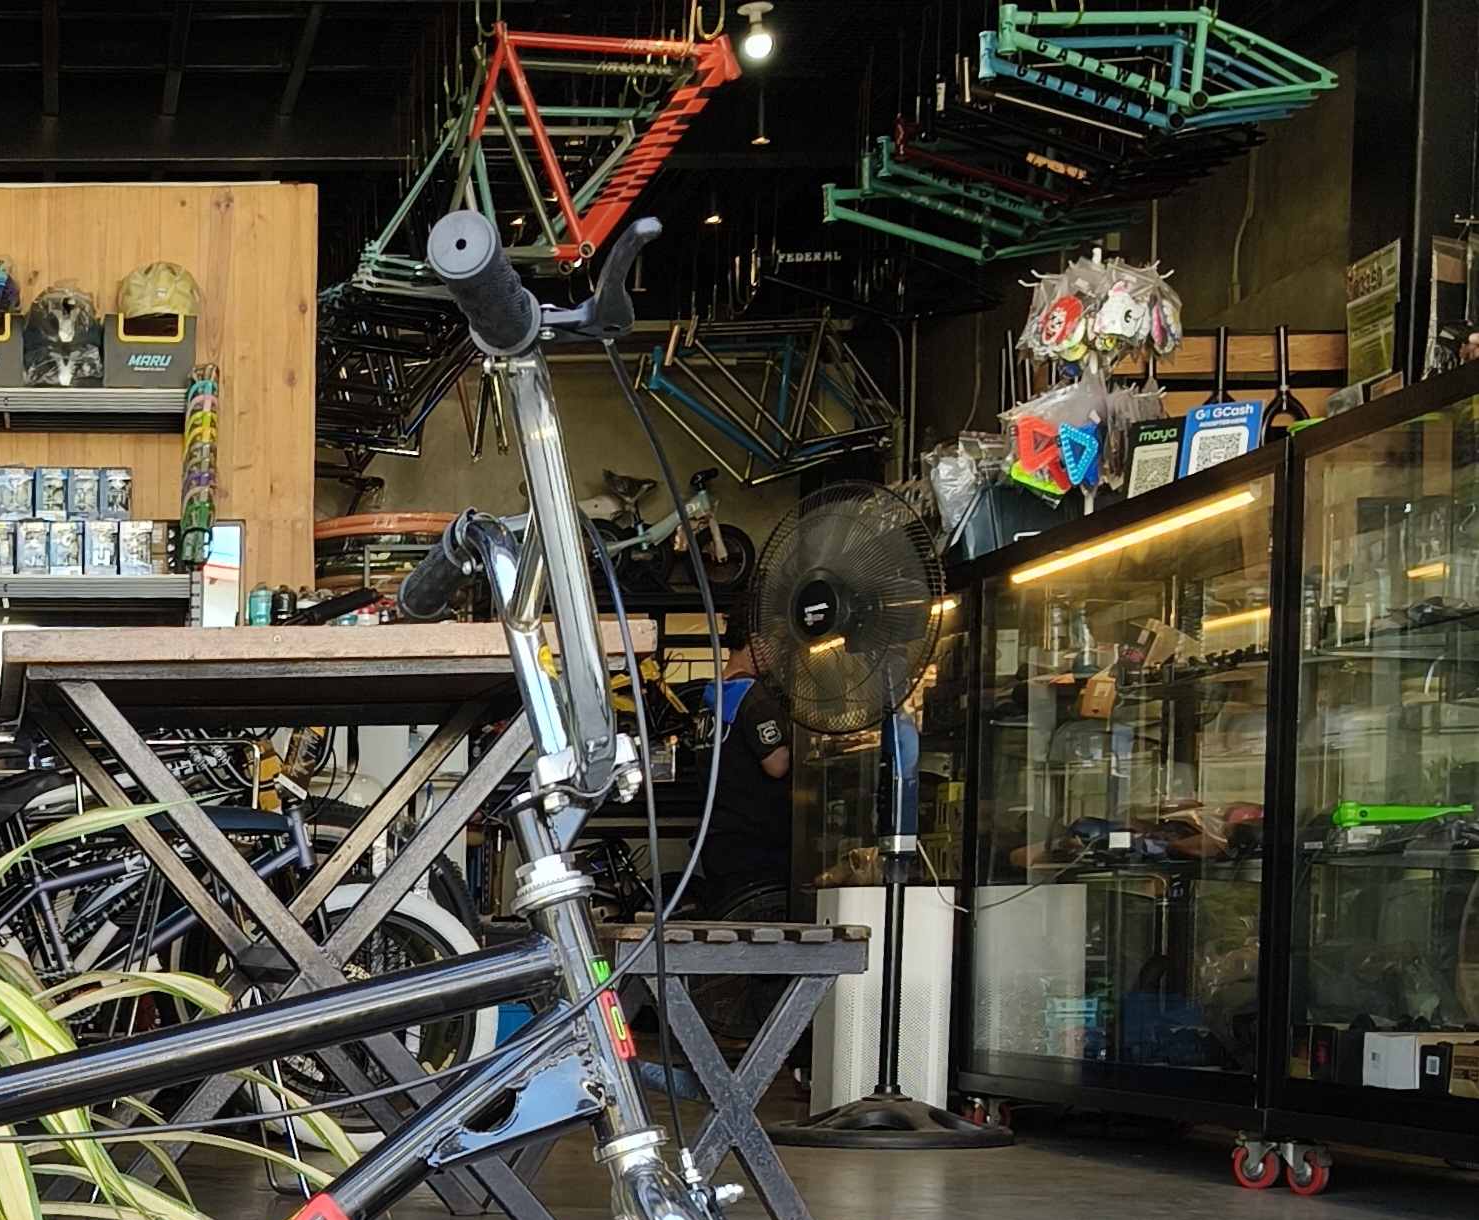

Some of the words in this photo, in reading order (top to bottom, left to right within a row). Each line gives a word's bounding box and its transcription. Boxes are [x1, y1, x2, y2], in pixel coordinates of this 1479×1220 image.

[1036, 40, 1172, 98] GATEWAY
[1016, 66, 1150, 120] GATEWAY
[777, 251, 842, 263] FEDERAL
[128, 354, 172, 366] MARU
[1213, 404, 1254, 418] GCash
[1138, 428, 1178, 442] maya
